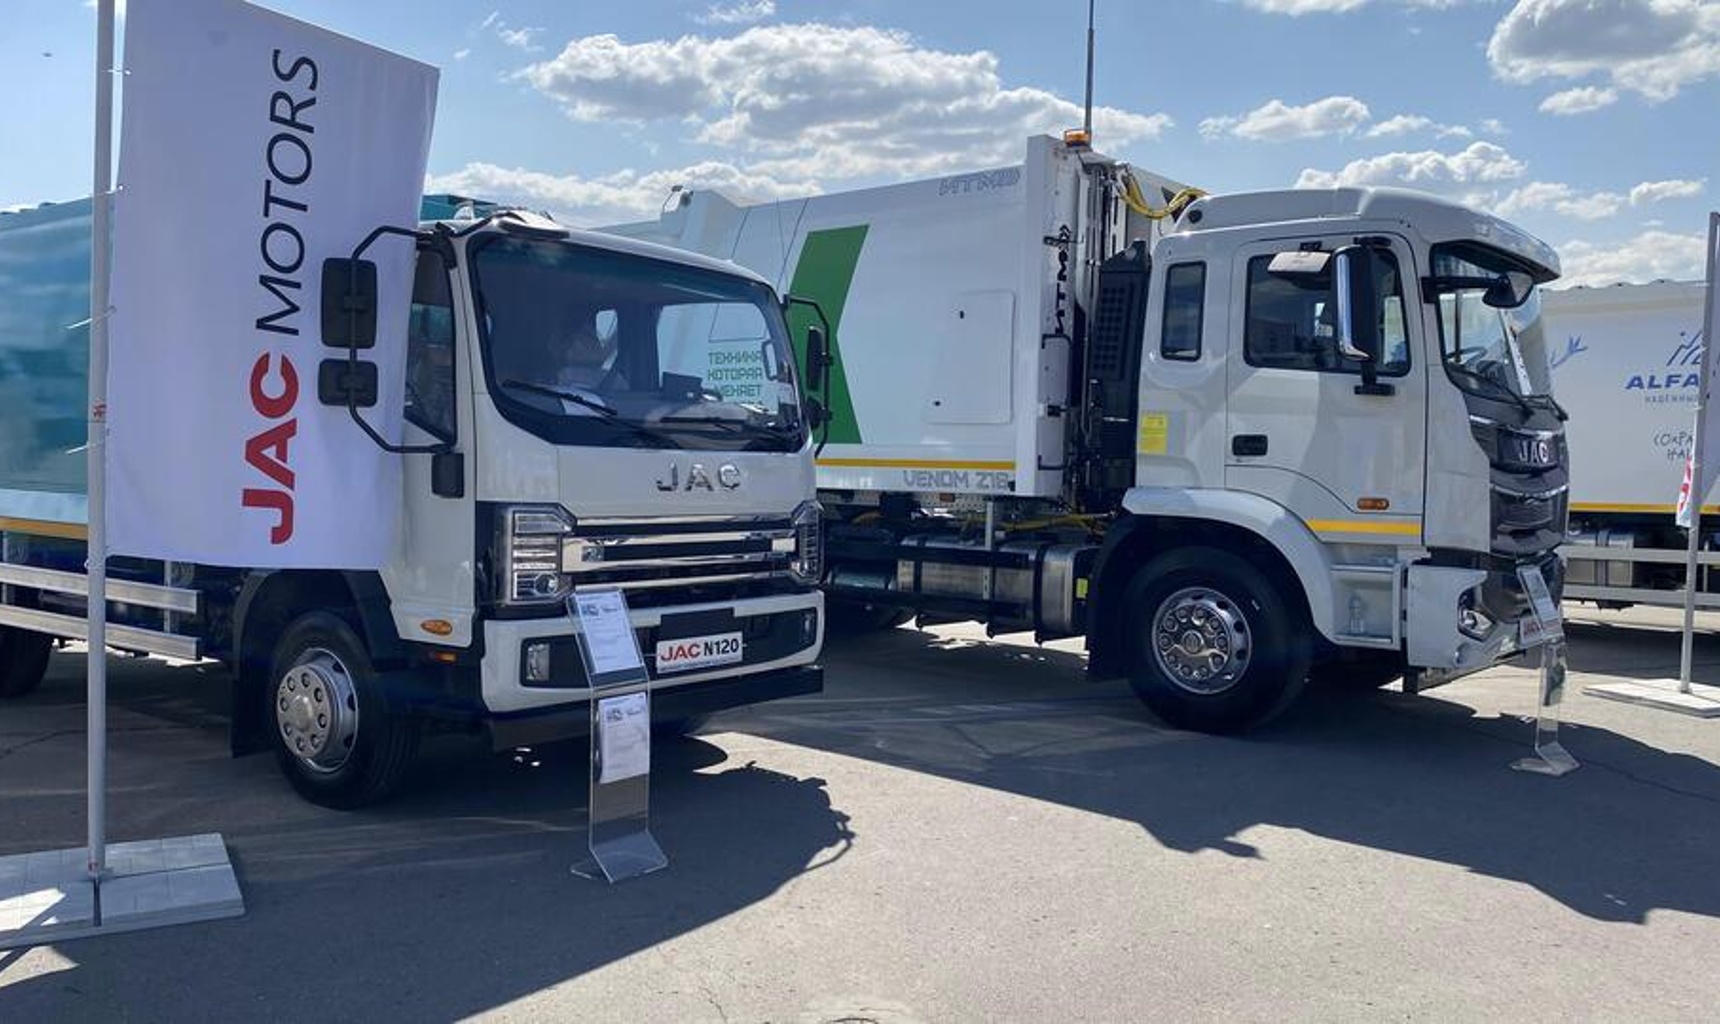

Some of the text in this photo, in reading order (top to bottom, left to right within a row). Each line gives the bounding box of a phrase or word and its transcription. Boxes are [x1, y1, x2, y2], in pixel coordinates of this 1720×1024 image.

[242, 48, 319, 545] JAC MOTORS
[1625, 373, 1699, 390] ALFA
[1518, 440, 1549, 464] JAC
[656, 461, 741, 492] JAC
[902, 470, 969, 488] VENOM
[660, 638, 740, 662] JAC N120
